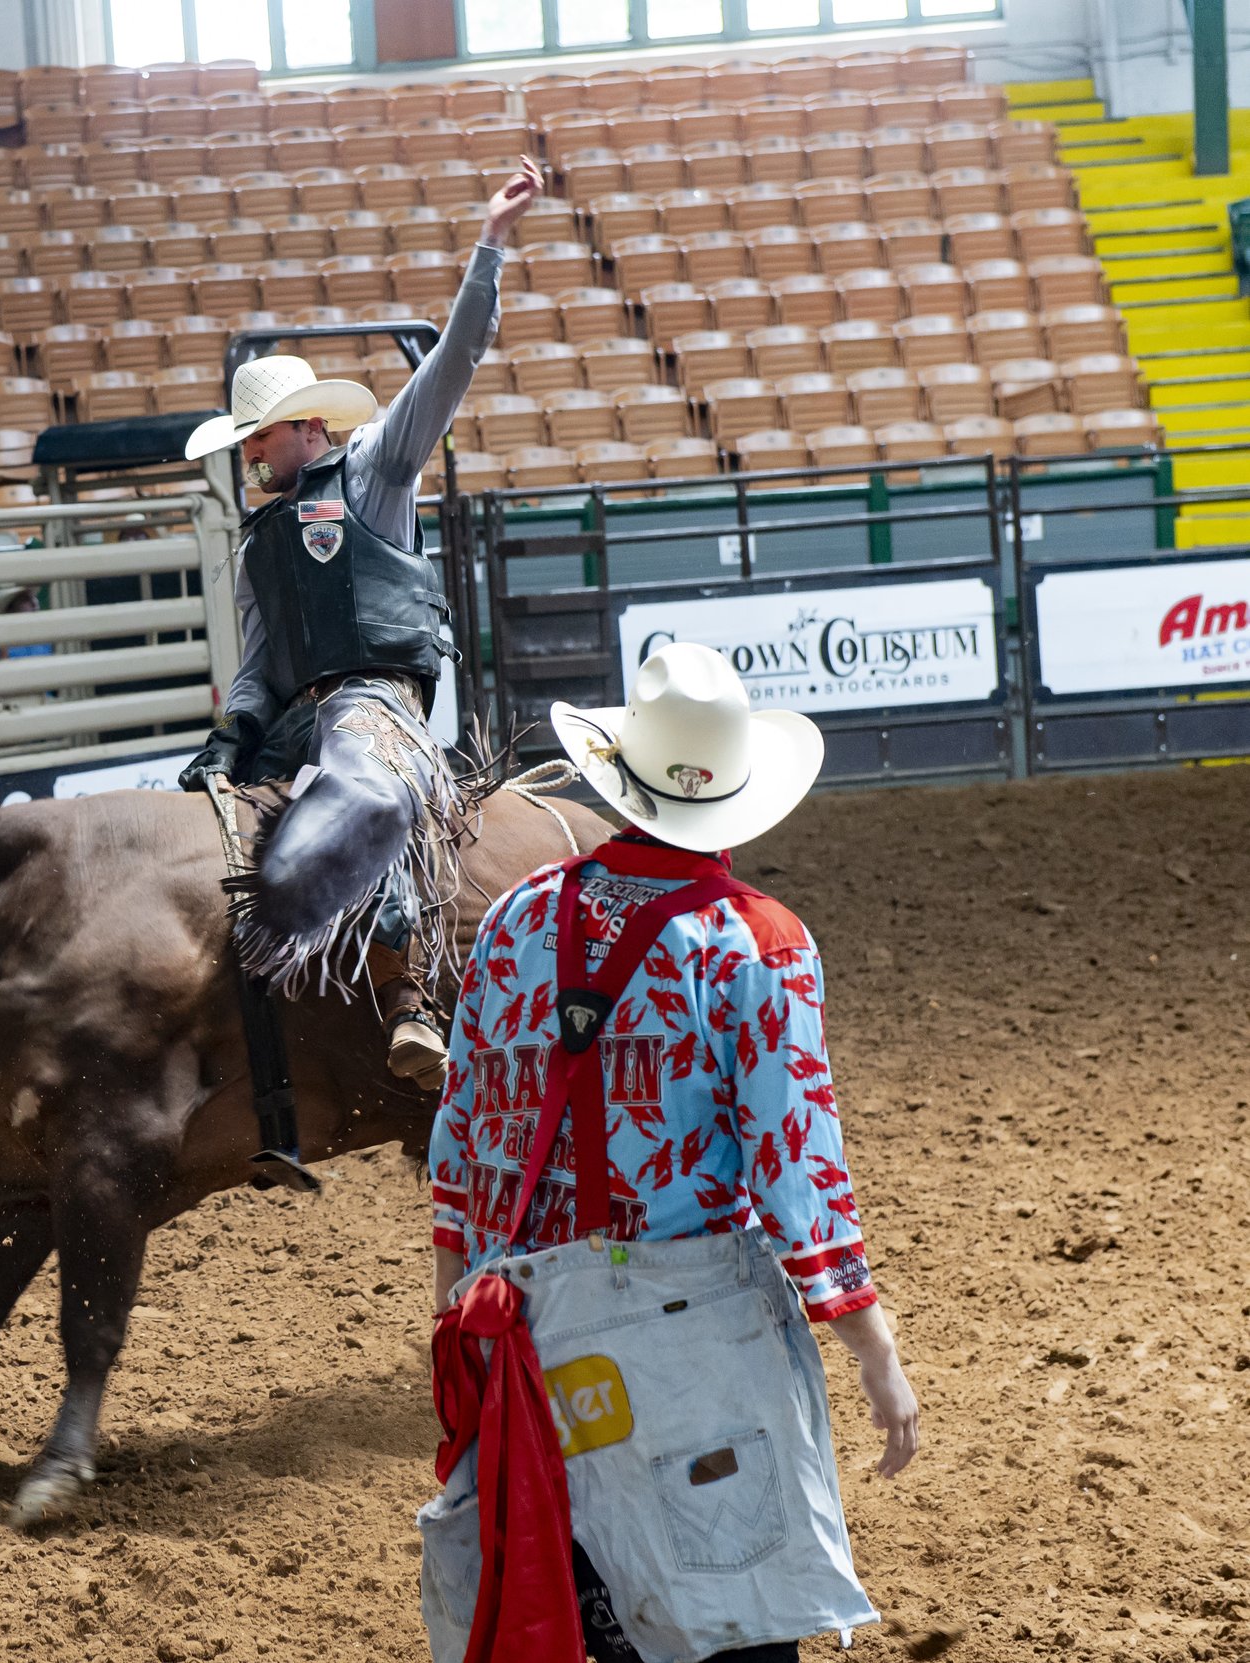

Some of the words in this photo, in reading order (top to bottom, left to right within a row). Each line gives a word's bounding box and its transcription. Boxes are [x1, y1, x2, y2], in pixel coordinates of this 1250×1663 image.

[819, 616, 983, 679] COLISEUM
[1181, 641, 1226, 662] HAT
[747, 685, 800, 701] ORTH
[824, 673, 951, 695] STOCKYARDS
